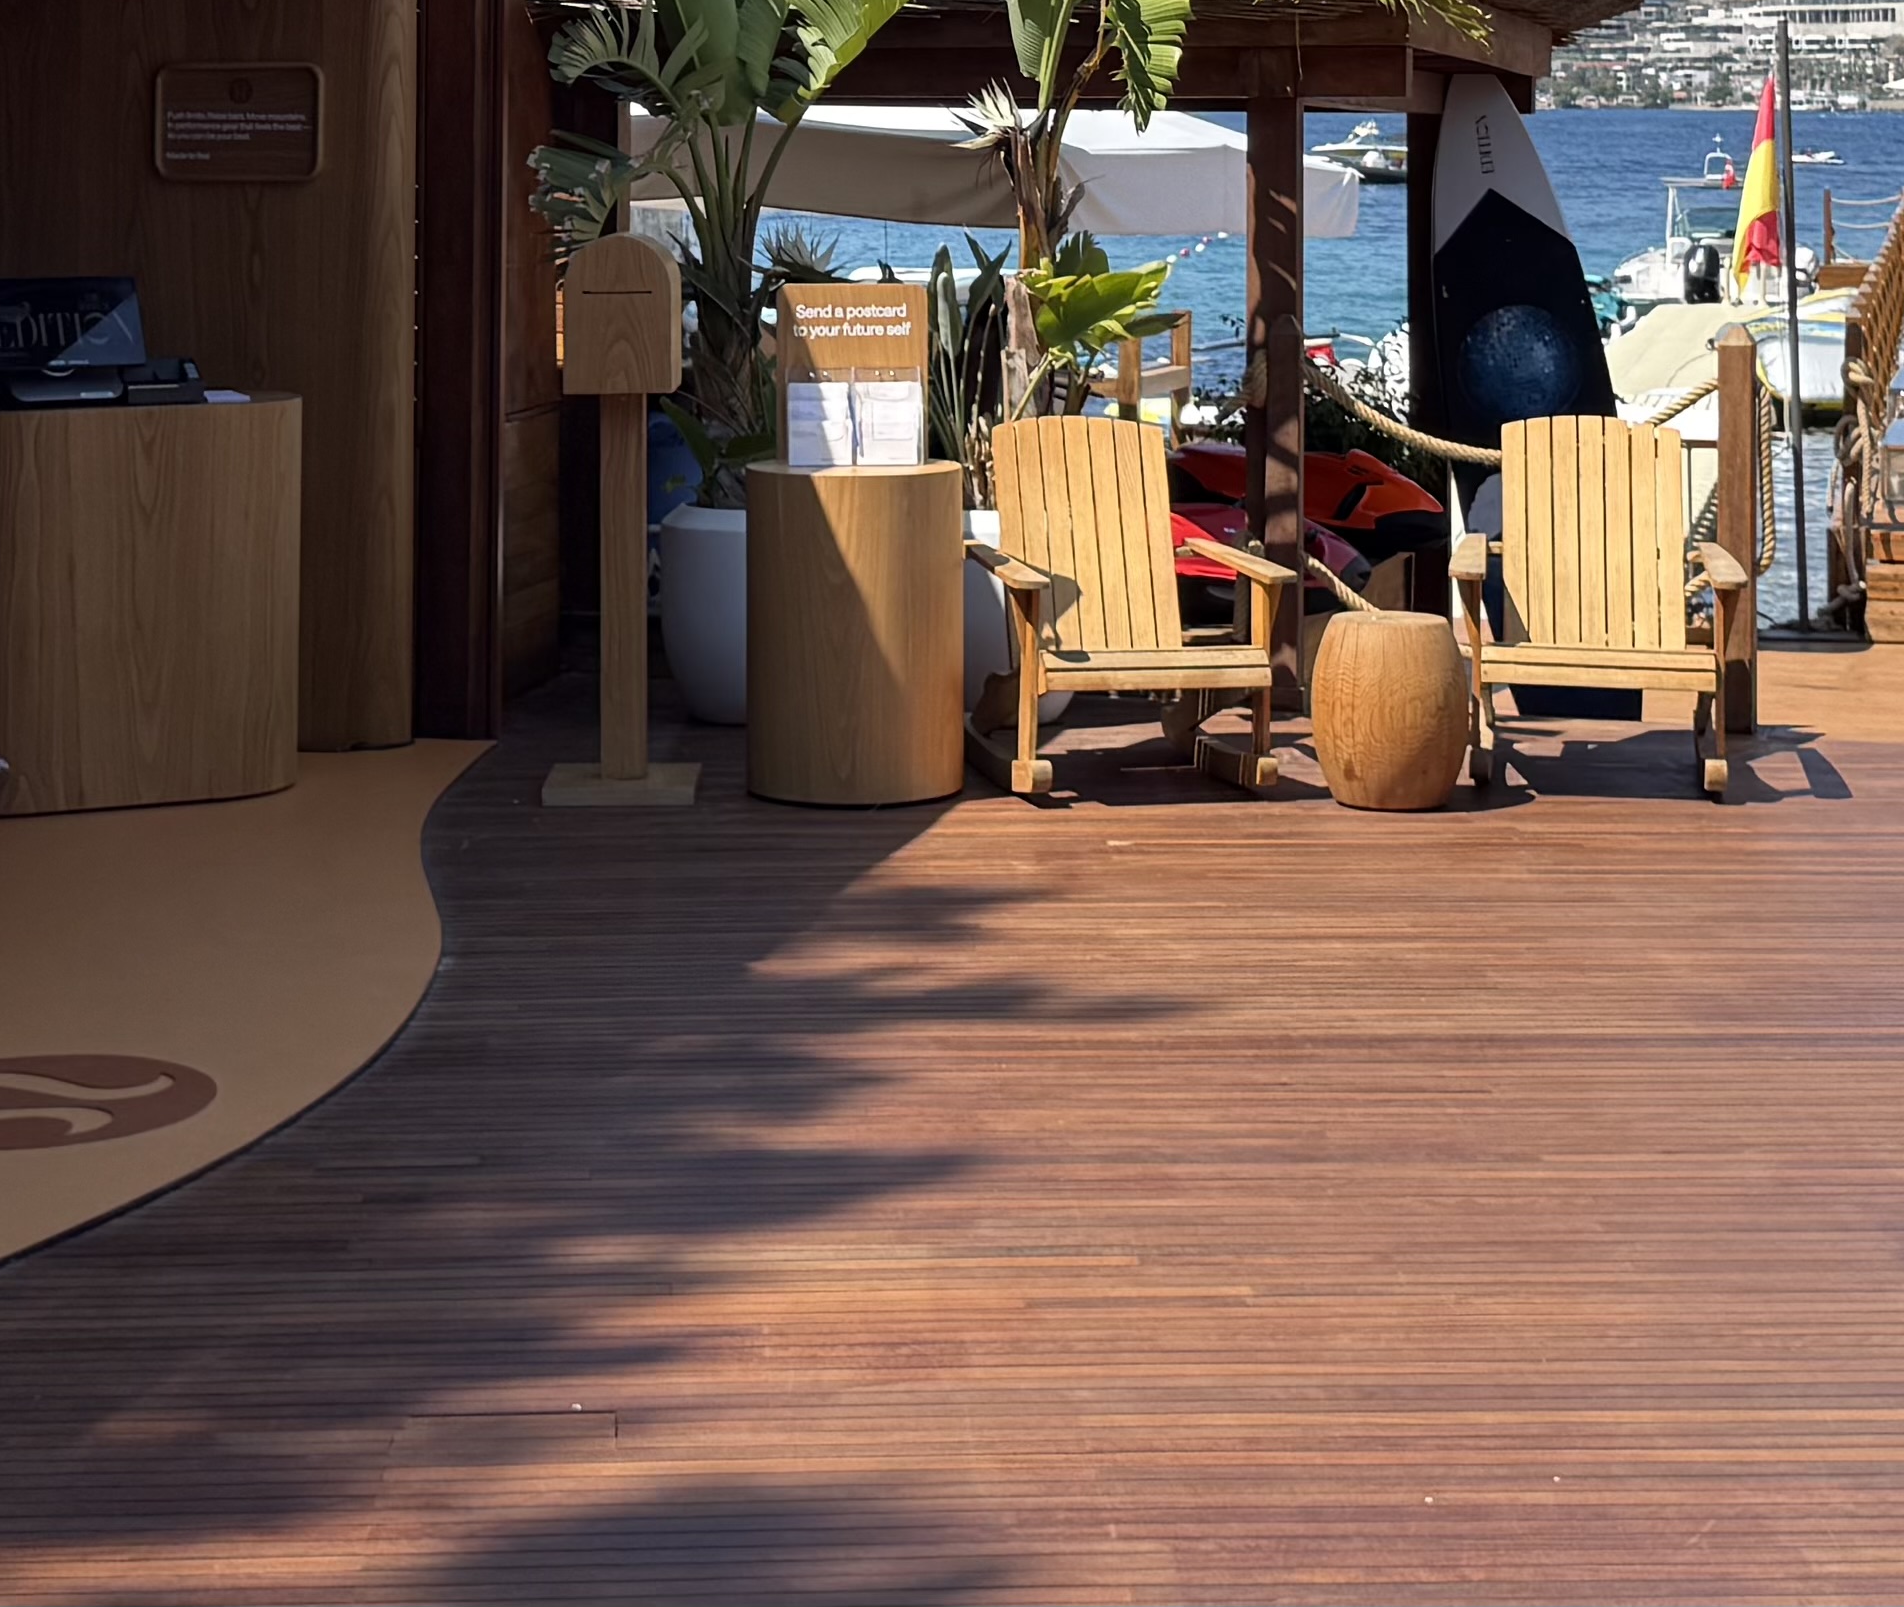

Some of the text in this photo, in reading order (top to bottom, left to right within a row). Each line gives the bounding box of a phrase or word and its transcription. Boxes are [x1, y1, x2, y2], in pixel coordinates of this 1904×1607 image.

[795, 303, 907, 320] Send a postcard
[793, 321, 911, 340] to your future self
